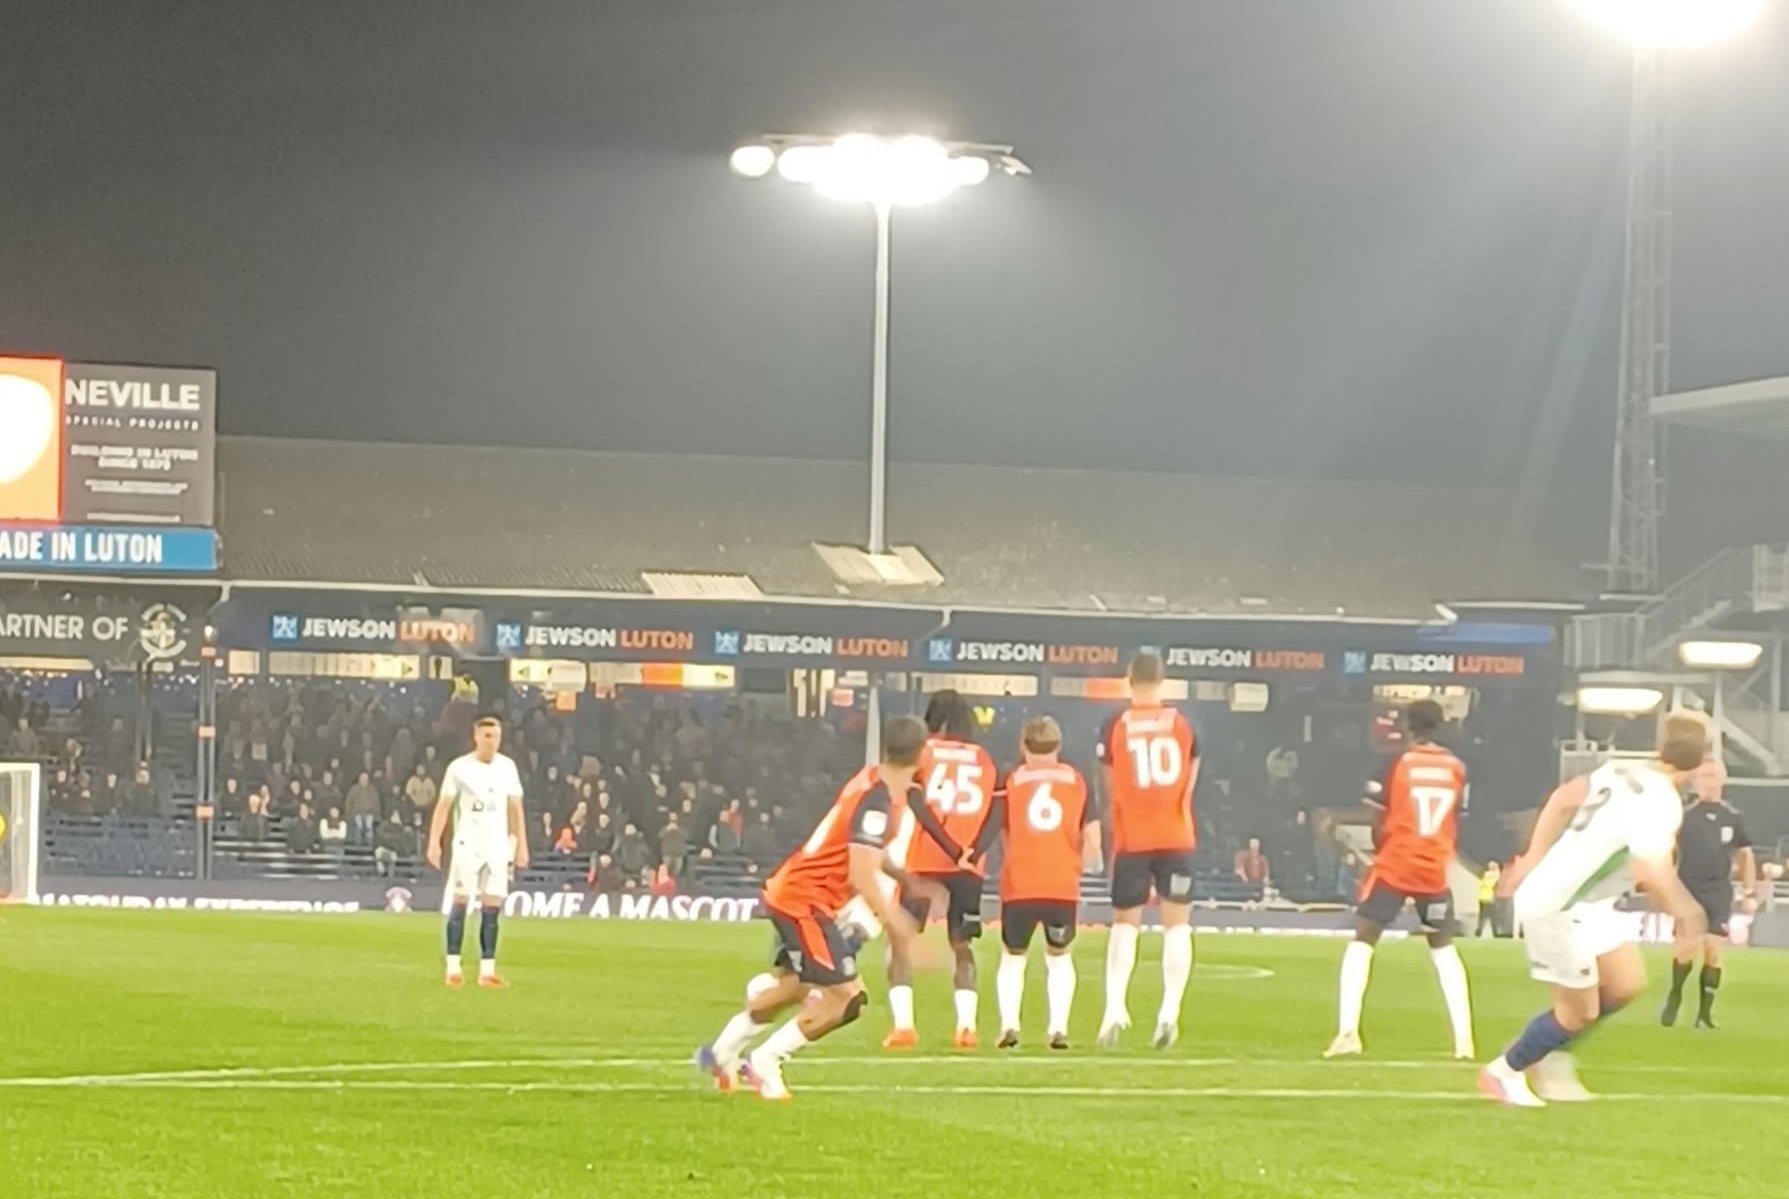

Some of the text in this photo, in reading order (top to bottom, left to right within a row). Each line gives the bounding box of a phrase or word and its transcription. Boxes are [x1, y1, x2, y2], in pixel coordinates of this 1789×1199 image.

[65, 378, 200, 411] NEVILLE
[52, 532, 76, 560] IN
[84, 532, 163, 563] LUTON
[92, 616, 128, 640] OF
[302, 617, 475, 642] JEWSON LUTON
[524, 625, 694, 650] JEWSON LUTON
[743, 634, 909, 658] JEWSON LUTON
[957, 642, 1119, 663] JEWSON LUTON
[1166, 647, 1252, 668] JEWSON
[1370, 653, 1454, 673] JEWSON
[1126, 737, 1182, 789] 10
[926, 763, 984, 816] 45
[1028, 782, 1063, 831] 6
[1410, 786, 1456, 837] 17
[590, 893, 610, 918] A
[619, 894, 759, 922] MASCOT
